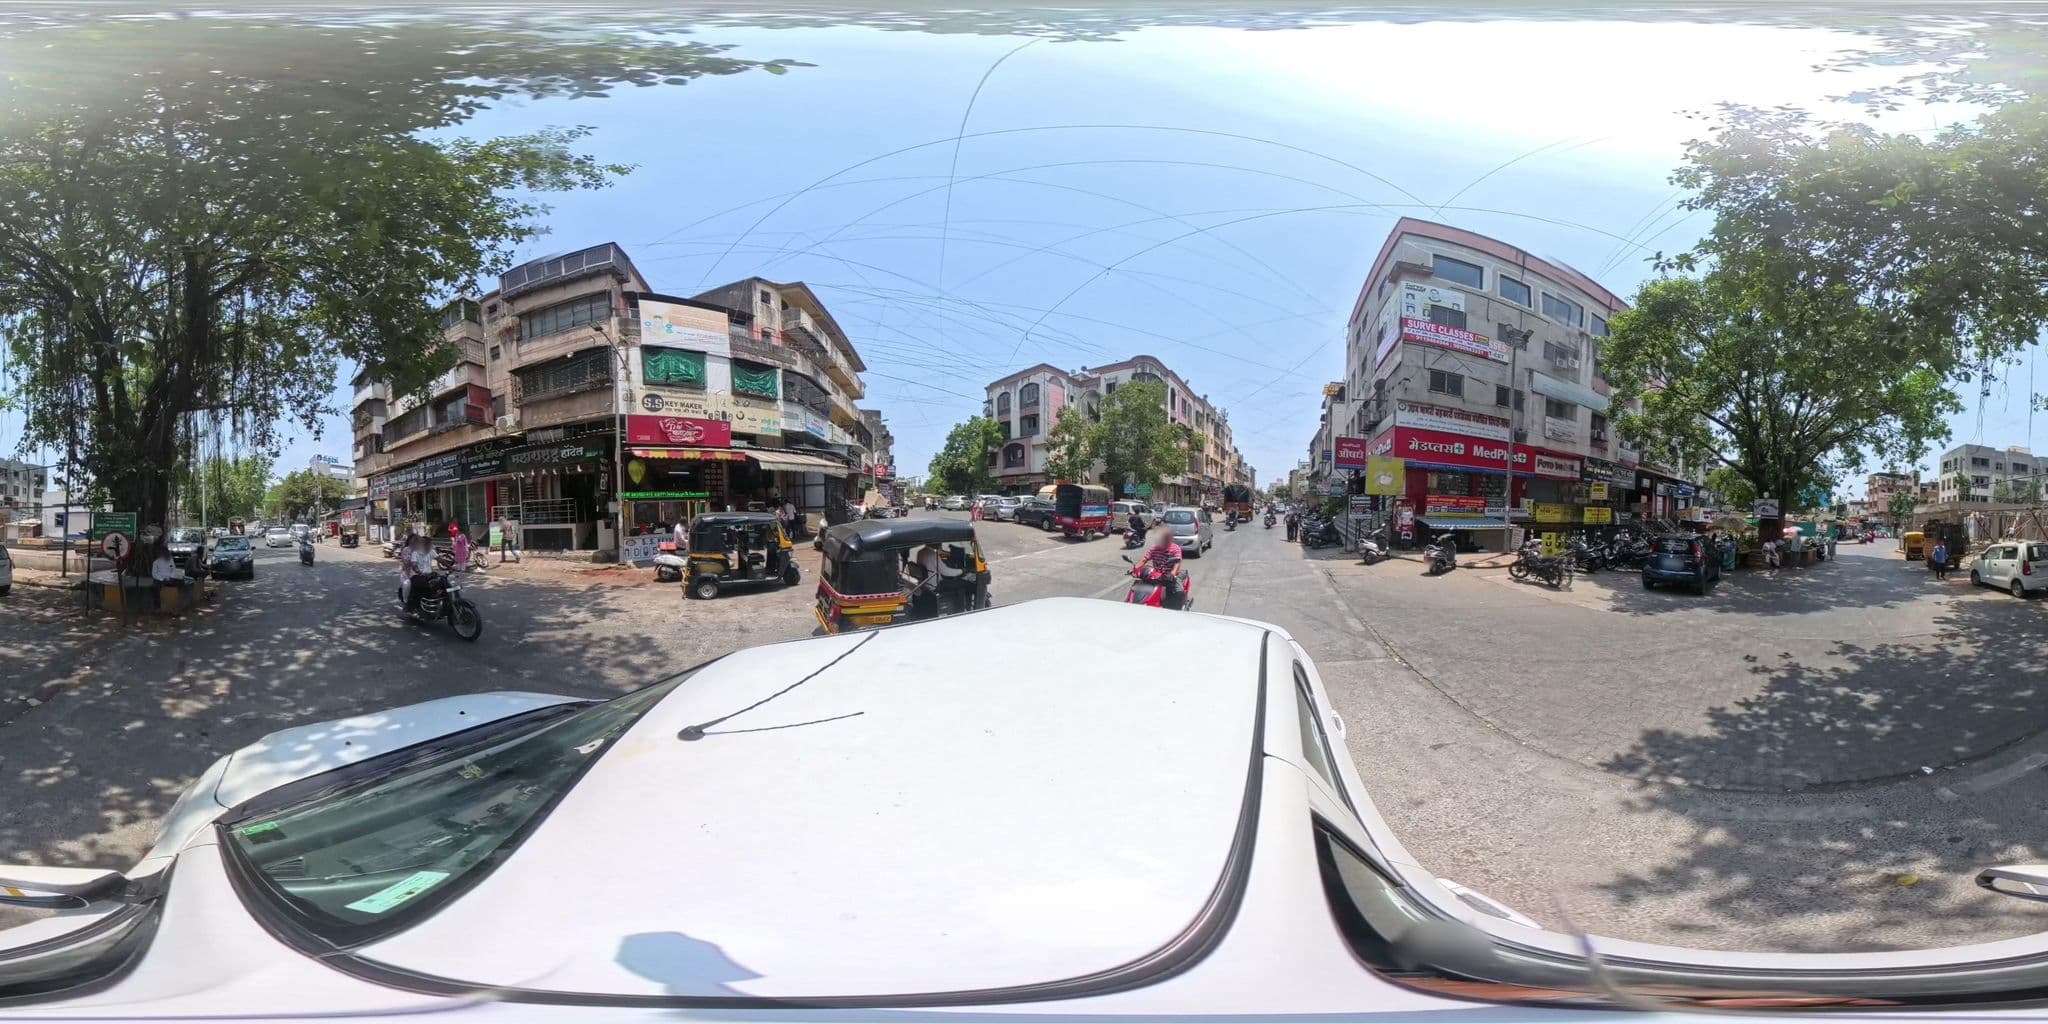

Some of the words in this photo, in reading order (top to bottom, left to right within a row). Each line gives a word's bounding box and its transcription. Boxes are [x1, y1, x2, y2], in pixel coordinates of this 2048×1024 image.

[1407, 320, 1437, 333] SURVE
[1438, 325, 1474, 341] CLASSES
[643, 397, 663, 409] S.S
[680, 401, 703, 410] MAKER
[560, 444, 584, 459] हॉटेल
[1408, 437, 1454, 454] मेडप्लस
[1473, 445, 1520, 462] MedPls
